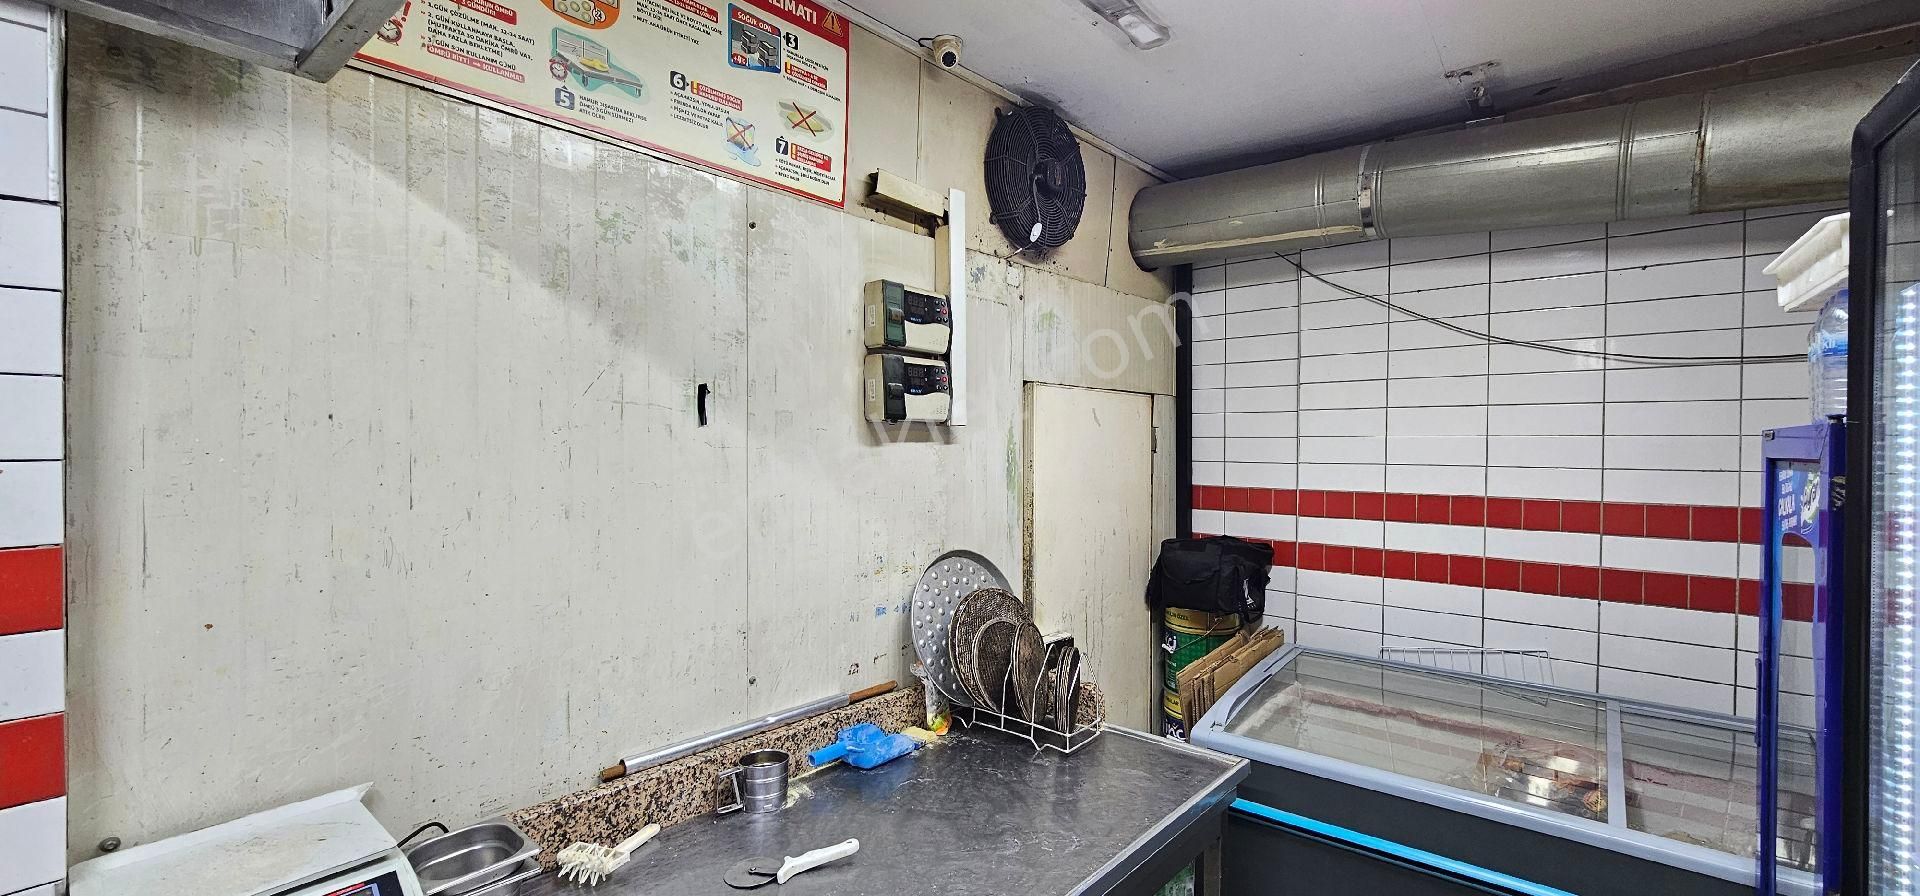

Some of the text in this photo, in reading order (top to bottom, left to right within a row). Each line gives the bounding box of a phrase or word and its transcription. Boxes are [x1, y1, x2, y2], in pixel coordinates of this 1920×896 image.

[786, 33, 796, 48] 3
[673, 73, 684, 88] 6
[560, 91, 571, 107] 5
[778, 140, 786, 154] 7
